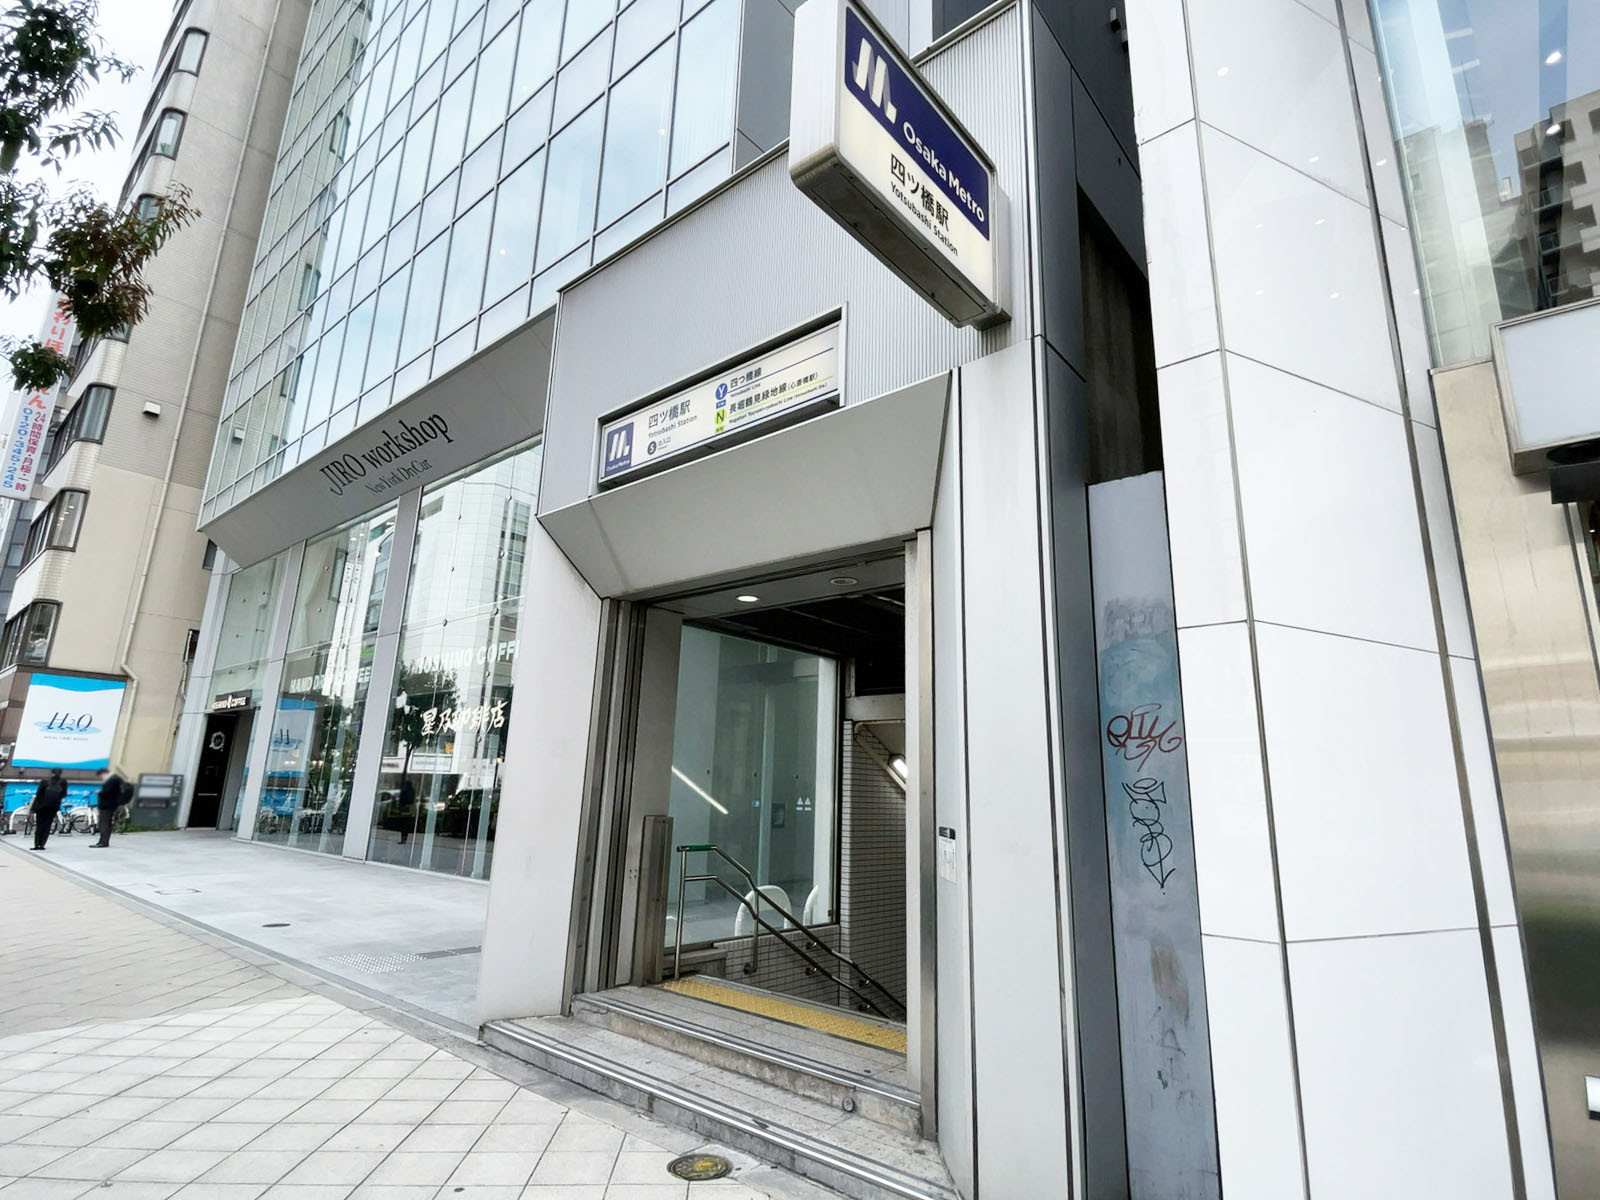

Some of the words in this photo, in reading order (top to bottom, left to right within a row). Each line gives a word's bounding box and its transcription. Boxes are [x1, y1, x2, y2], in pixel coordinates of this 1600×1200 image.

[891, 153, 949, 232] 四ツ橋駅
[903, 121, 947, 182] Osaka
[948, 169, 985, 223] Metro
[890, 181, 932, 230] Yotsubashi
[933, 225, 958, 257] Station
[730, 367, 762, 388] 四つ橋線
[648, 399, 691, 429] 四ツ橋駅
[648, 422, 676, 439] Yotsubashi
[676, 414, 698, 428] Station
[319, 453, 366, 496] JIRO
[361, 414, 454, 470] workshop
[289, 676, 314, 694] HAND
